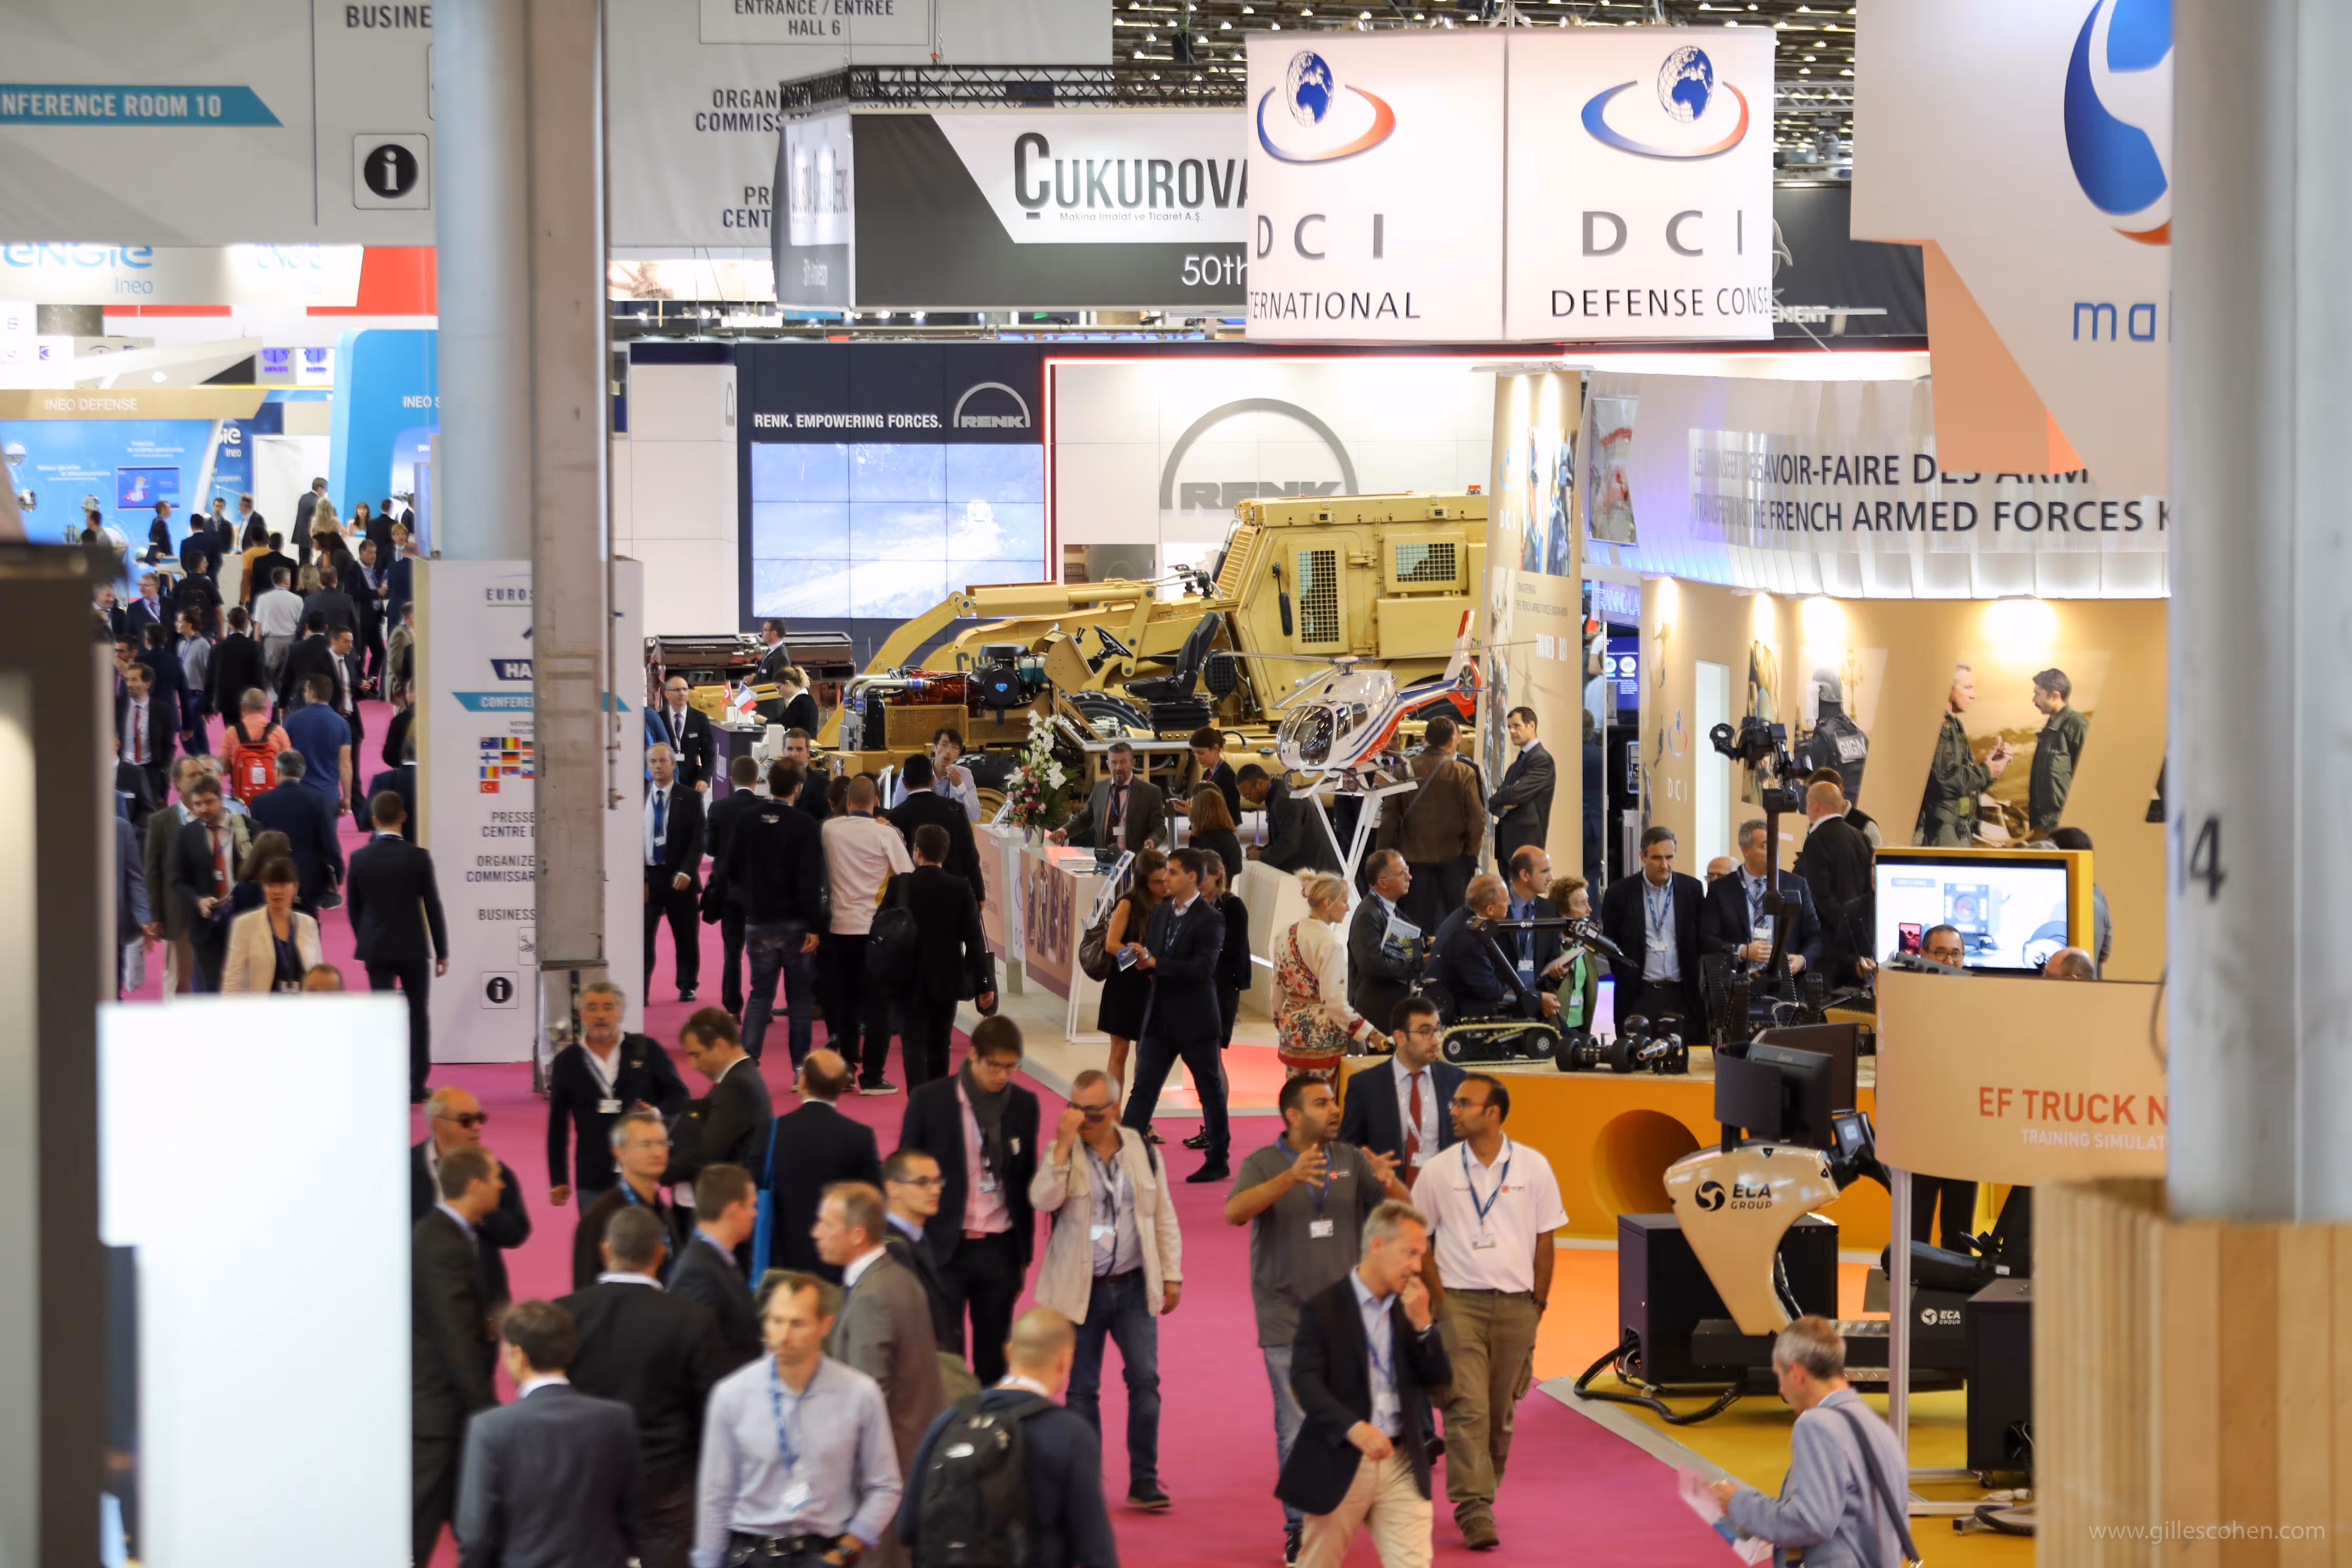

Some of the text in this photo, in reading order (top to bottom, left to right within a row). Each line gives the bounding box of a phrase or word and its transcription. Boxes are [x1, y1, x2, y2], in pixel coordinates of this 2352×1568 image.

[789, 19, 840, 36] HALL 6
[0, 94, 221, 117] NFERENCE ROOM 10
[713, 89, 780, 109] ORGAN
[744, 187, 773, 205] PR
[1060, 212, 1096, 221] Makina
[1149, 212, 1182, 221] Ticaret
[1257, 213, 1384, 260] DCI
[1582, 209, 1742, 257] DCI
[114, 277, 154, 295] Ineo
[1552, 289, 1703, 317] DEFENSE
[2073, 302, 2172, 342] ma
[44, 399, 138, 411] INEO DEFENSE
[403, 396, 433, 409] INEO
[754, 413, 943, 429] RENK. EMPOWERING FORCES.
[961, 415, 1025, 428] RENK
[1770, 501, 1843, 532] FRENCH
[1853, 502, 1978, 532] ARMED
[1994, 501, 2144, 532] FORCES
[1840, 738, 1867, 756] GIGN
[1667, 776, 1688, 803] DCI
[482, 827, 526, 837] CENTRE
[1979, 1086, 2013, 1118] EF
[2022, 1090, 2138, 1125] TRUCK
[2021, 1129, 2090, 1148] TRAINING
[1732, 1183, 1771, 1199] ECA
[1731, 1201, 1772, 1210] GROUP
[1940, 1310, 1961, 1319] ECA
